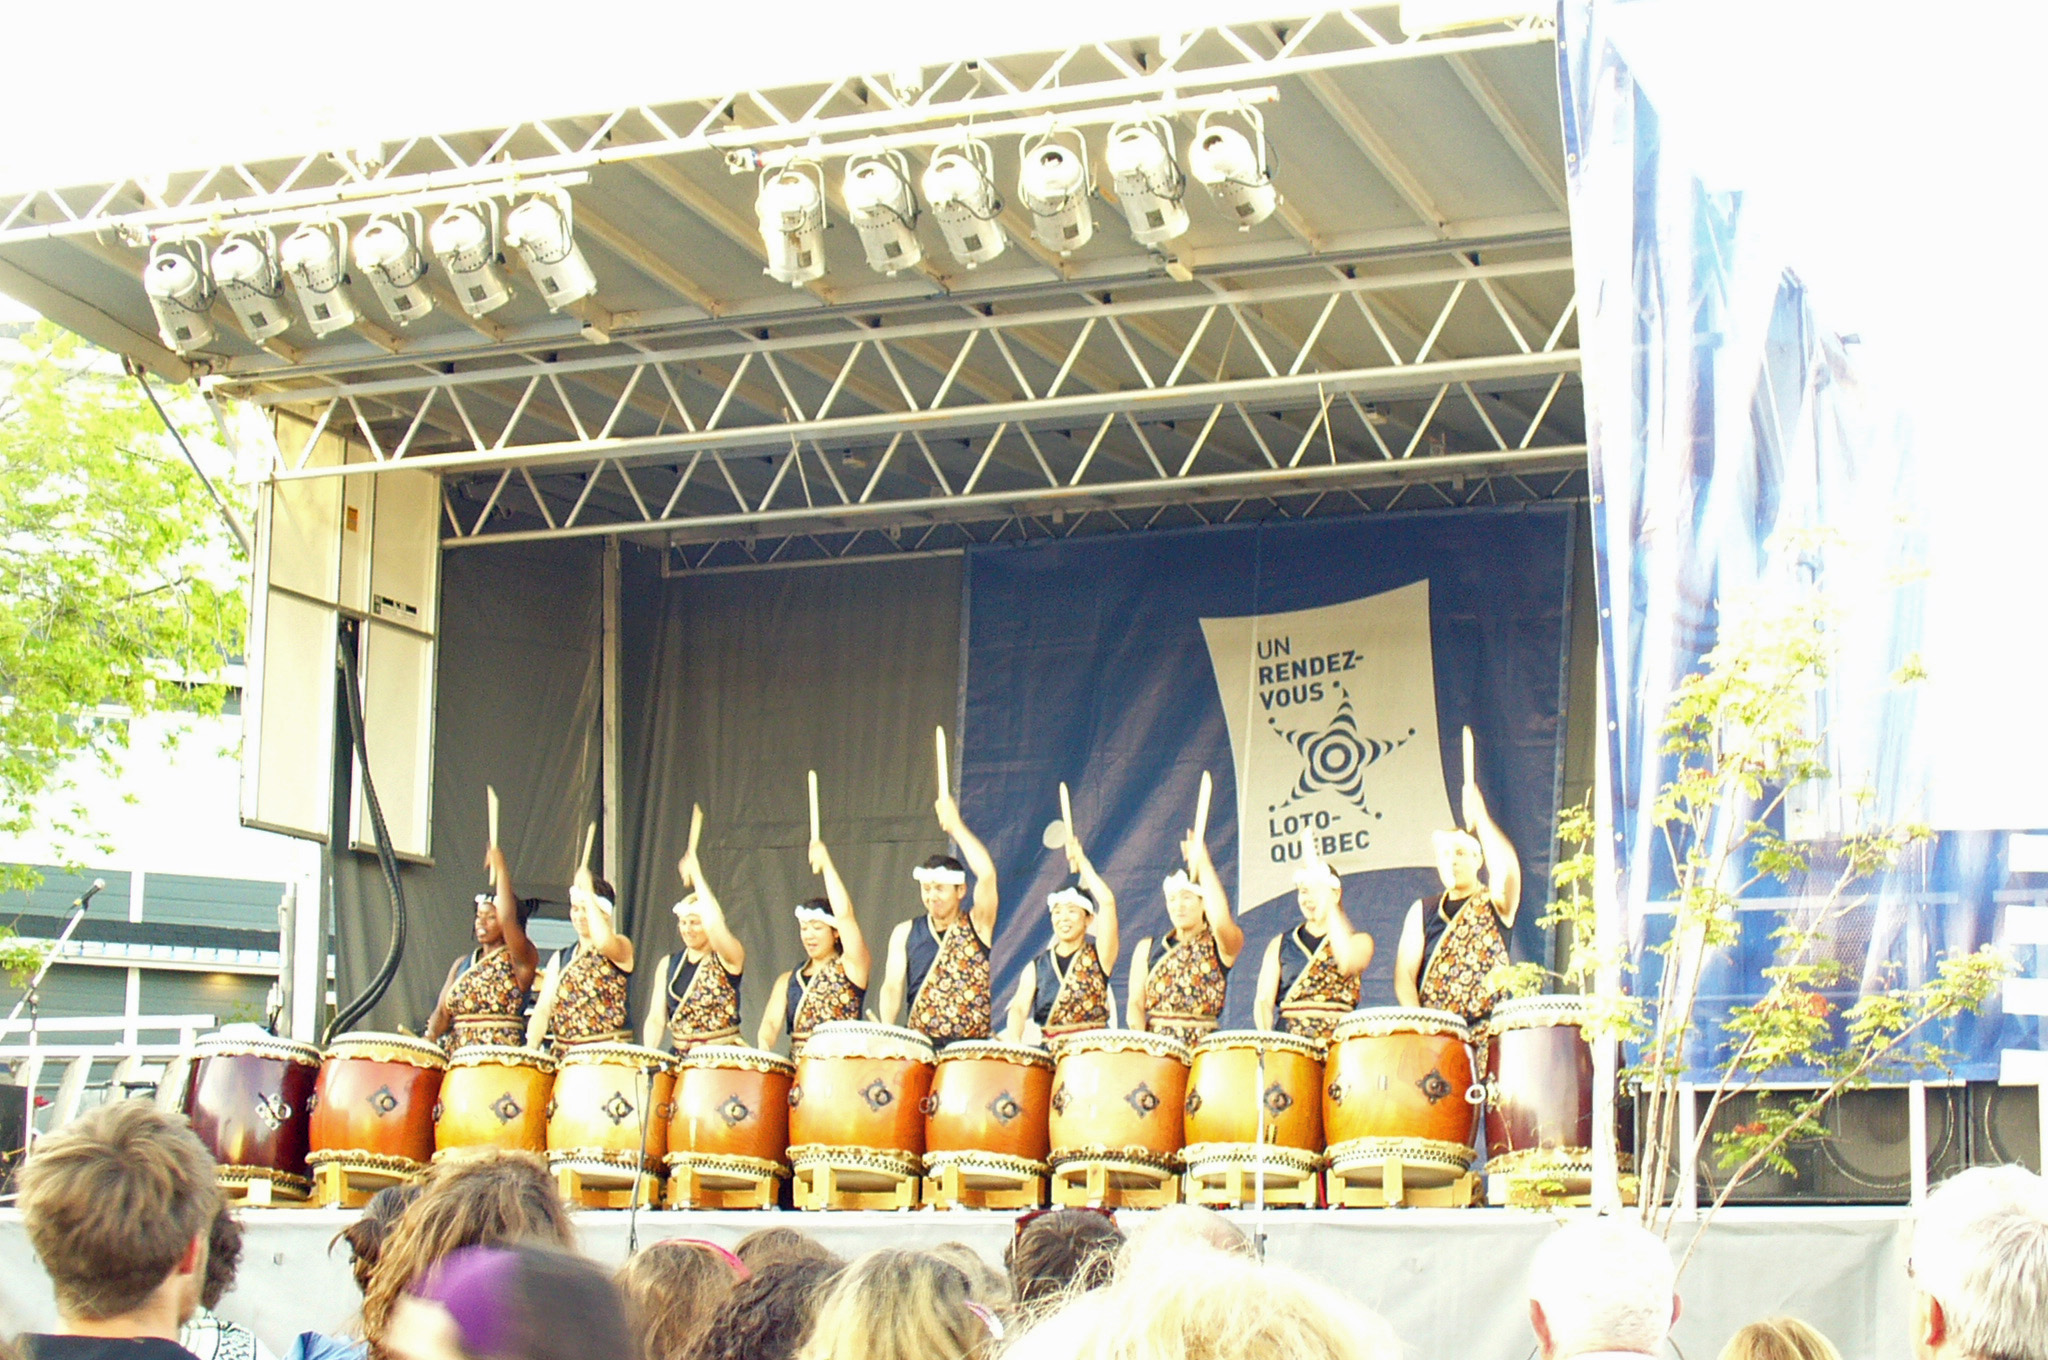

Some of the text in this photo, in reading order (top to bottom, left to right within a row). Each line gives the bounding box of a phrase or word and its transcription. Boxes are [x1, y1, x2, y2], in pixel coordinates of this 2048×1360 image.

[1257, 636, 1290, 660] UN
[1259, 650, 1364, 686] RENDEZ-
[1260, 682, 1324, 711] VOUS
[1269, 811, 1341, 838] LOTO-
